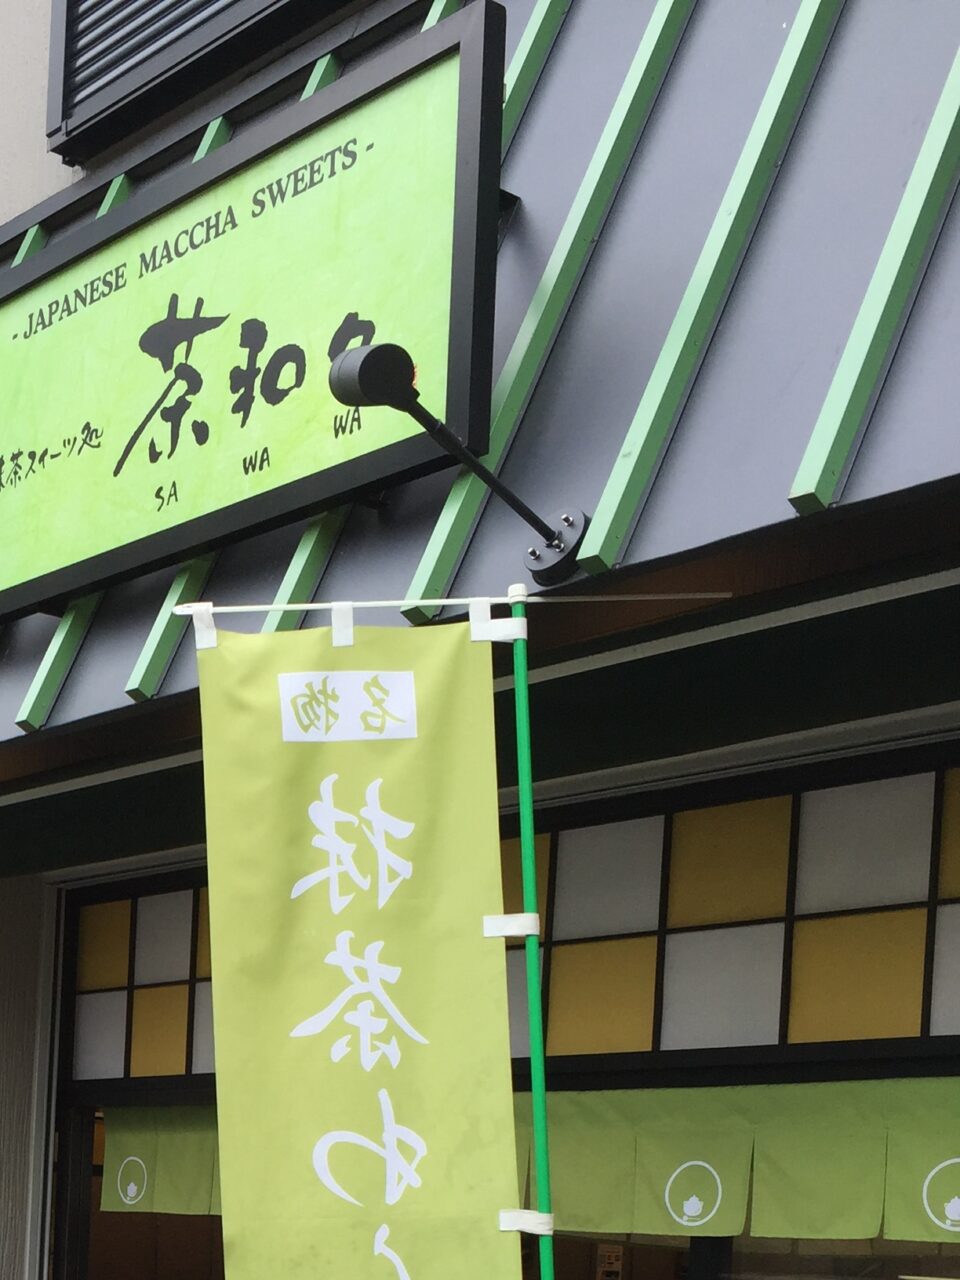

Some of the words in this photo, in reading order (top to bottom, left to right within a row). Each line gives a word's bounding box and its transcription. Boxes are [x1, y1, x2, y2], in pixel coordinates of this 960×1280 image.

[23, 263, 128, 341] JAPANESE
[138, 206, 239, 280] MACCHA
[250, 138, 359, 219] SWEETS
[154, 481, 179, 513] SA
[242, 446, 271, 477] WA
[333, 406, 363, 440] WA
